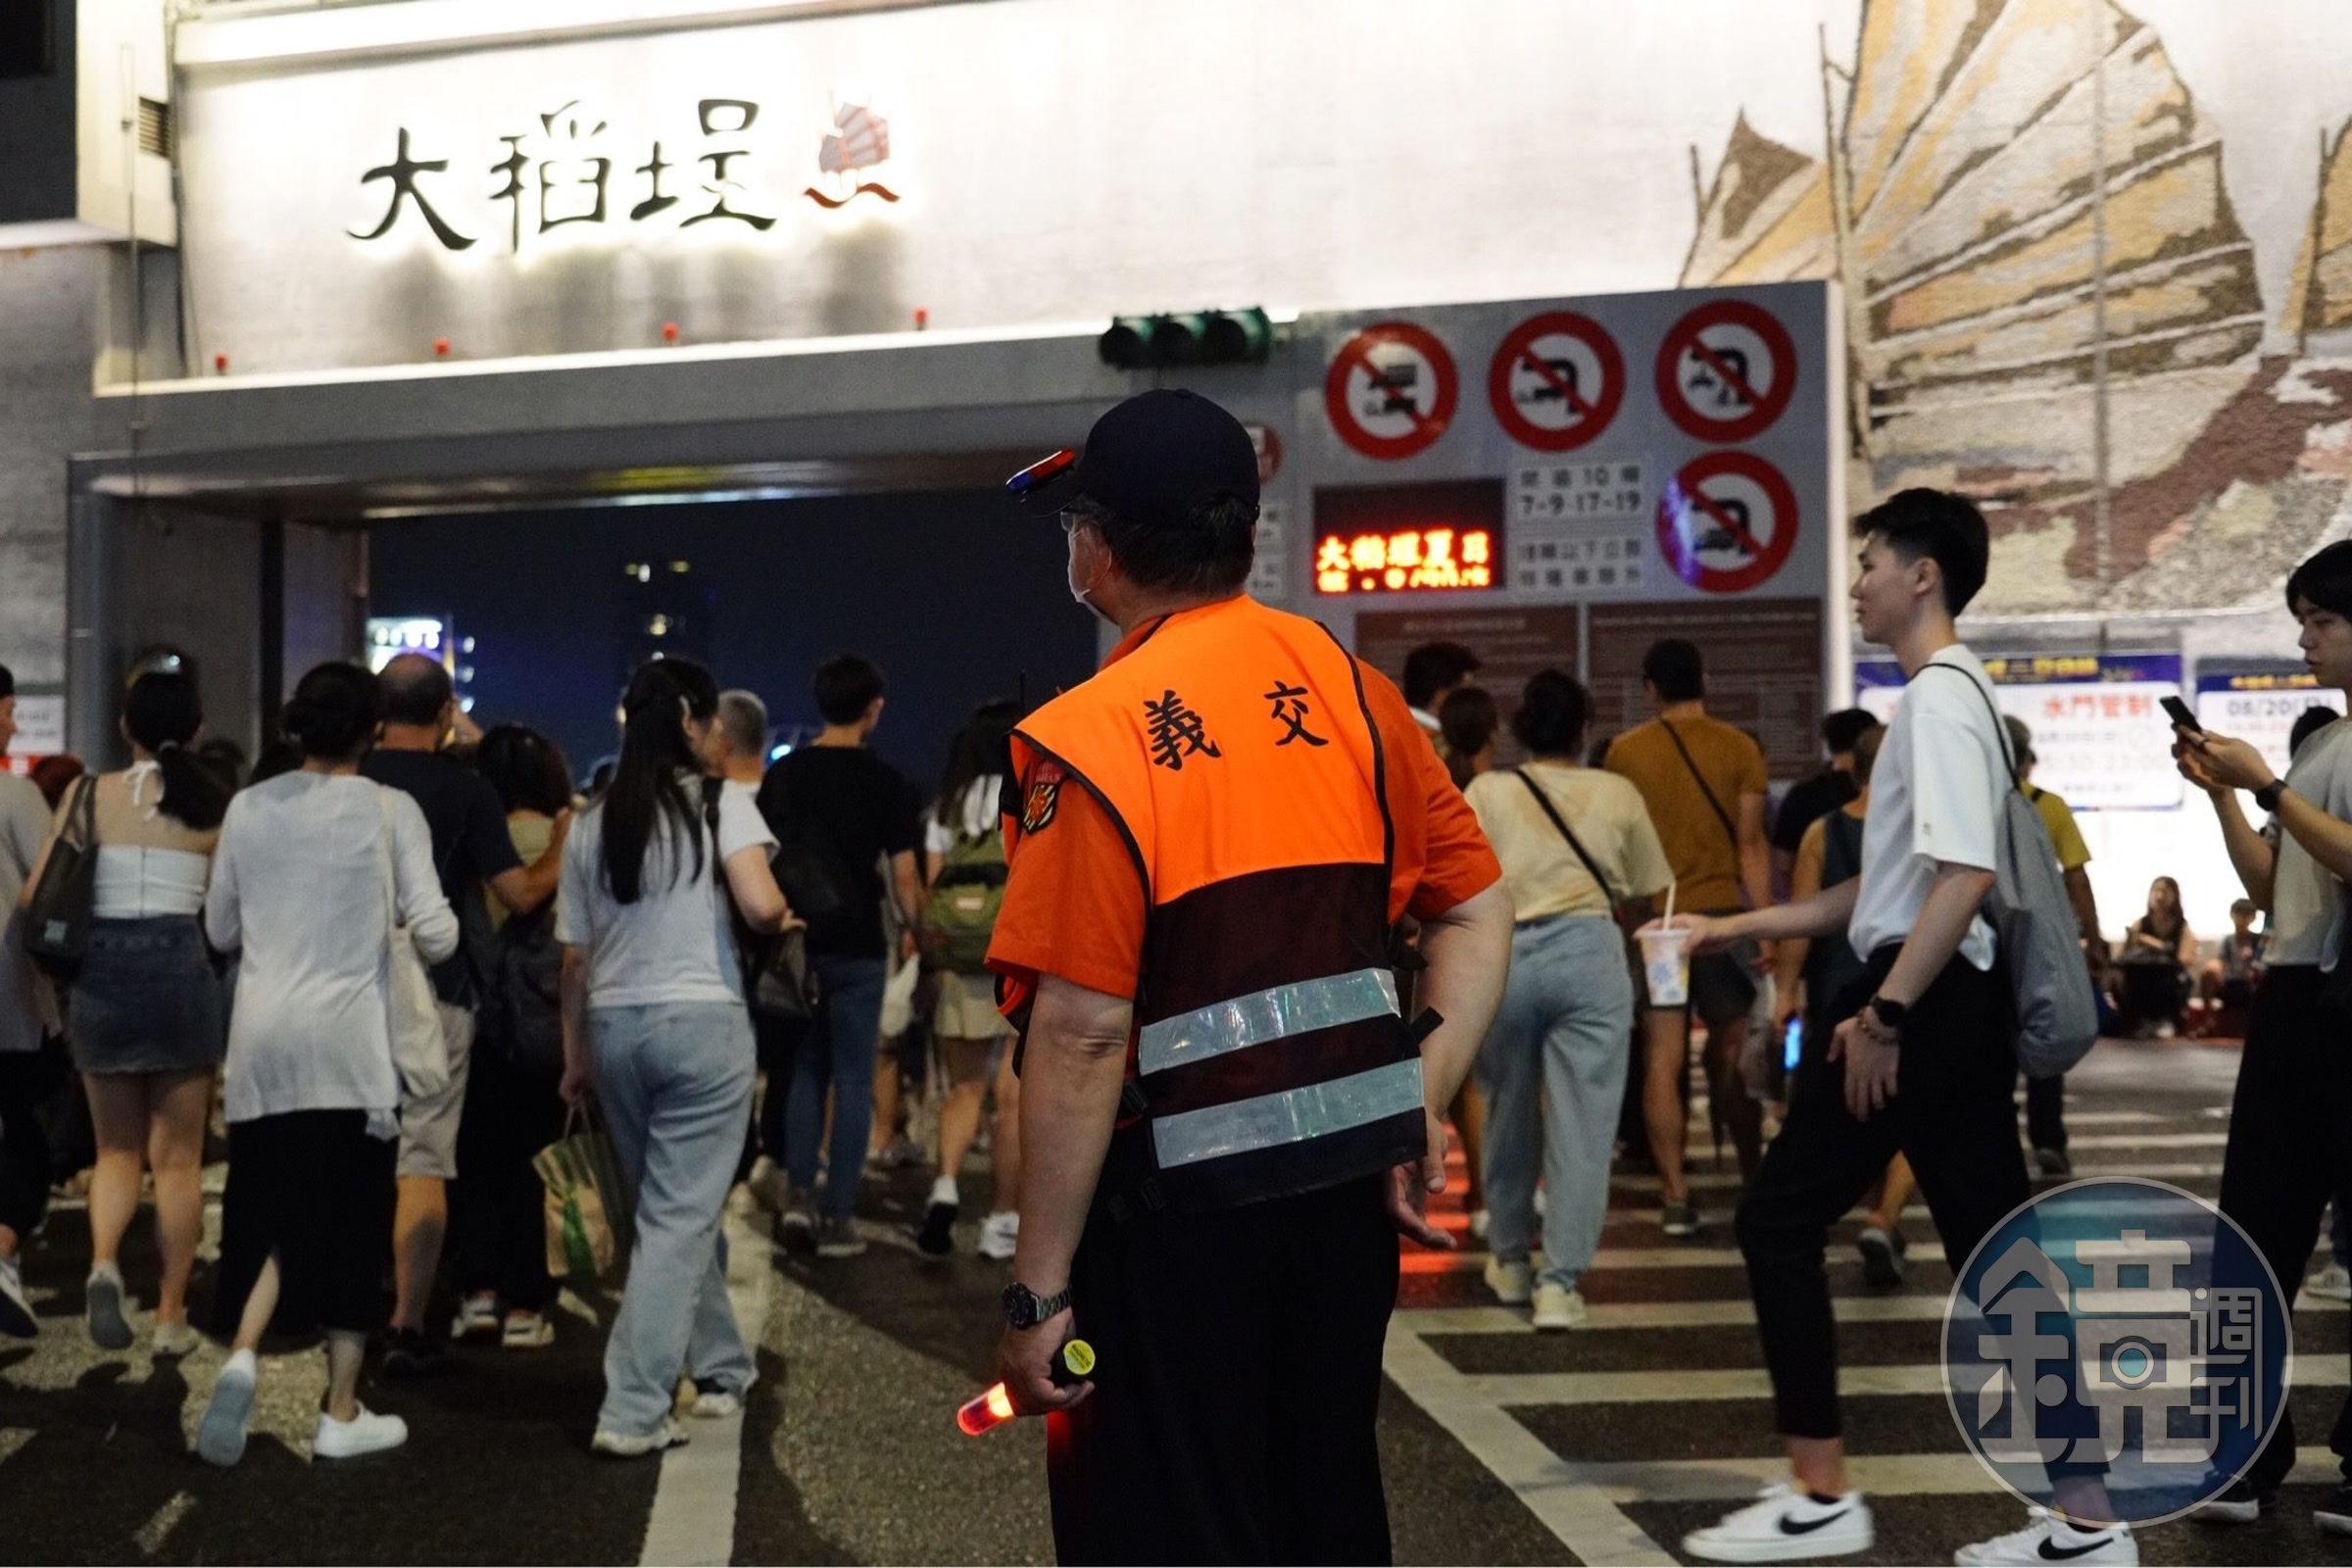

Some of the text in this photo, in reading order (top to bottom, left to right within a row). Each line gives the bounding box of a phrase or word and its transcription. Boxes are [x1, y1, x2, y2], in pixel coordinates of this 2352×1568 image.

[345, 99, 777, 253] 大稻埕
[1144, 680, 1329, 770] 義交
